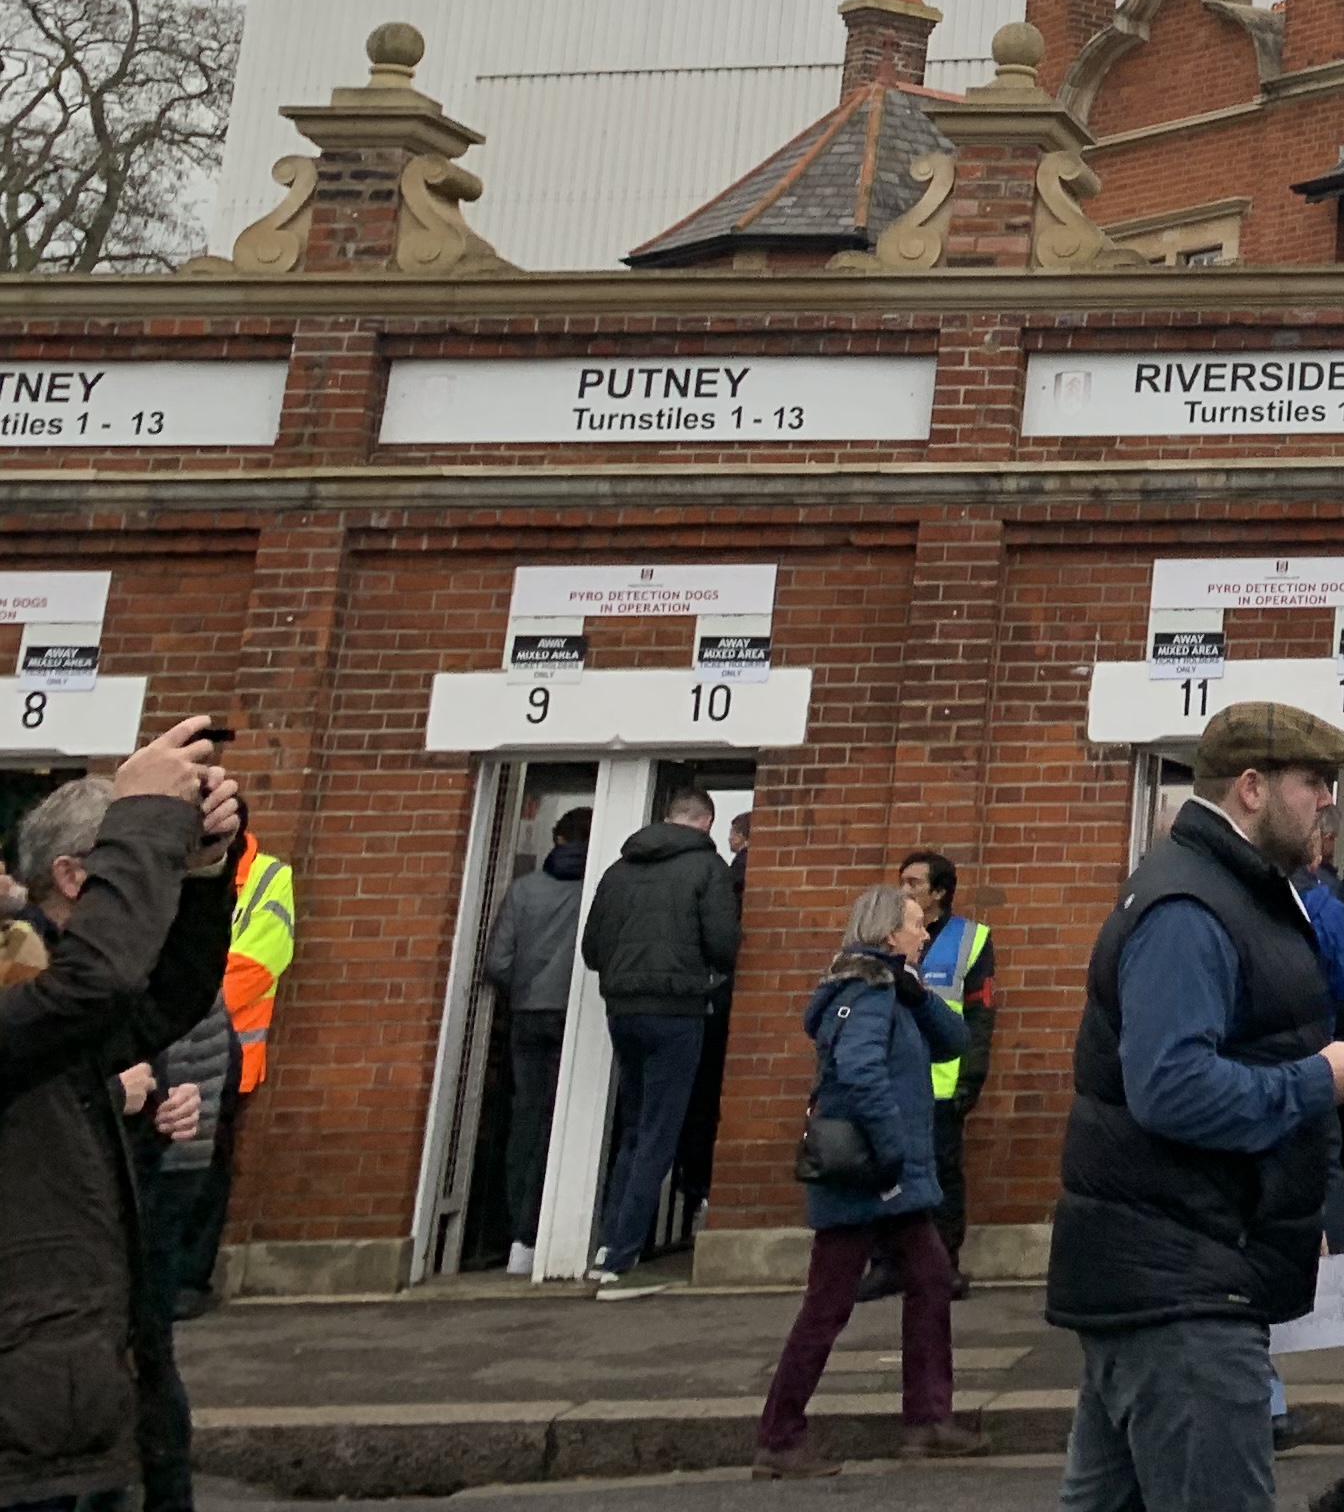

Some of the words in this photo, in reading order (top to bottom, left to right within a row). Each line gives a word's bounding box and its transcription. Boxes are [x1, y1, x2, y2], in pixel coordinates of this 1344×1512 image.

[0, 372, 105, 403] TNEY
[577, 368, 750, 399] PUTNEY
[1184, 399, 1327, 423] Turnstiles
[76, 412, 90, 435] 1
[131, 411, 165, 435] 13
[572, 407, 716, 430] Turnstiles
[731, 406, 744, 429] 1
[773, 406, 804, 430] 13
[1207, 583, 1241, 594] PYRO
[1246, 582, 1317, 593] DETECTION
[570, 590, 604, 601] PYRO
[608, 590, 680, 601] DETECTION
[685, 589, 719, 601] DOGS
[1238, 596, 1250, 605] IN
[1255, 595, 1327, 605] OPERATION
[600, 603, 612, 612] IN
[617, 603, 691, 613] OPERATION
[537, 638, 567, 648] AWAY
[717, 638, 751, 648] AWAY
[1172, 634, 1204, 644] AWAY
[703, 649, 735, 659] MIXED
[737, 648, 765, 659] AREA
[1157, 645, 1190, 655] MIXED
[1191, 644, 1218, 655] AREA
[1181, 679, 1208, 716] 11
[22, 691, 47, 728] 8
[526, 687, 550, 724] 9
[691, 684, 732, 722] 10
